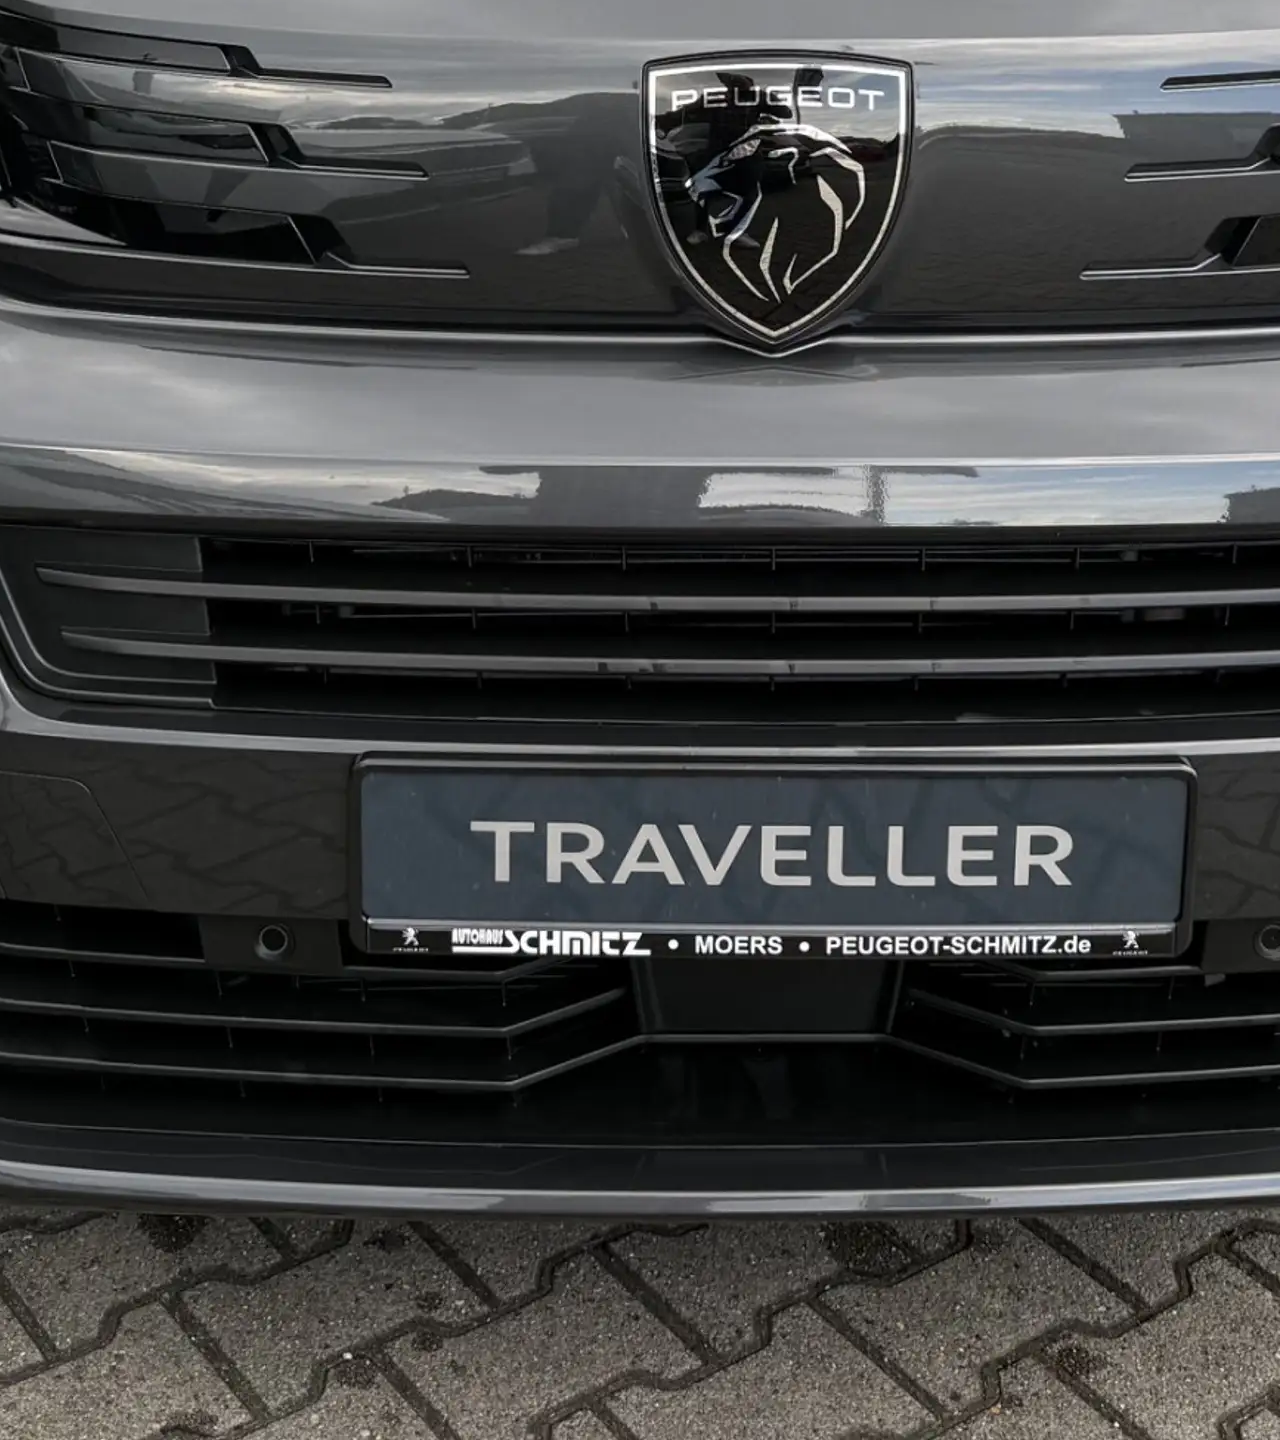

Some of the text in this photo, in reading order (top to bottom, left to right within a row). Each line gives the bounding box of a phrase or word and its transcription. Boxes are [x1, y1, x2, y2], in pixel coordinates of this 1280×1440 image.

[670, 86, 885, 112] PEUGEOT
[469, 820, 1074, 887] TRAVELLER
[451, 927, 504, 945] AUTOHAUS
[694, 934, 784, 956] MOERS
[825, 934, 1093, 957] PEUGEOT-SCHMITZ.de
